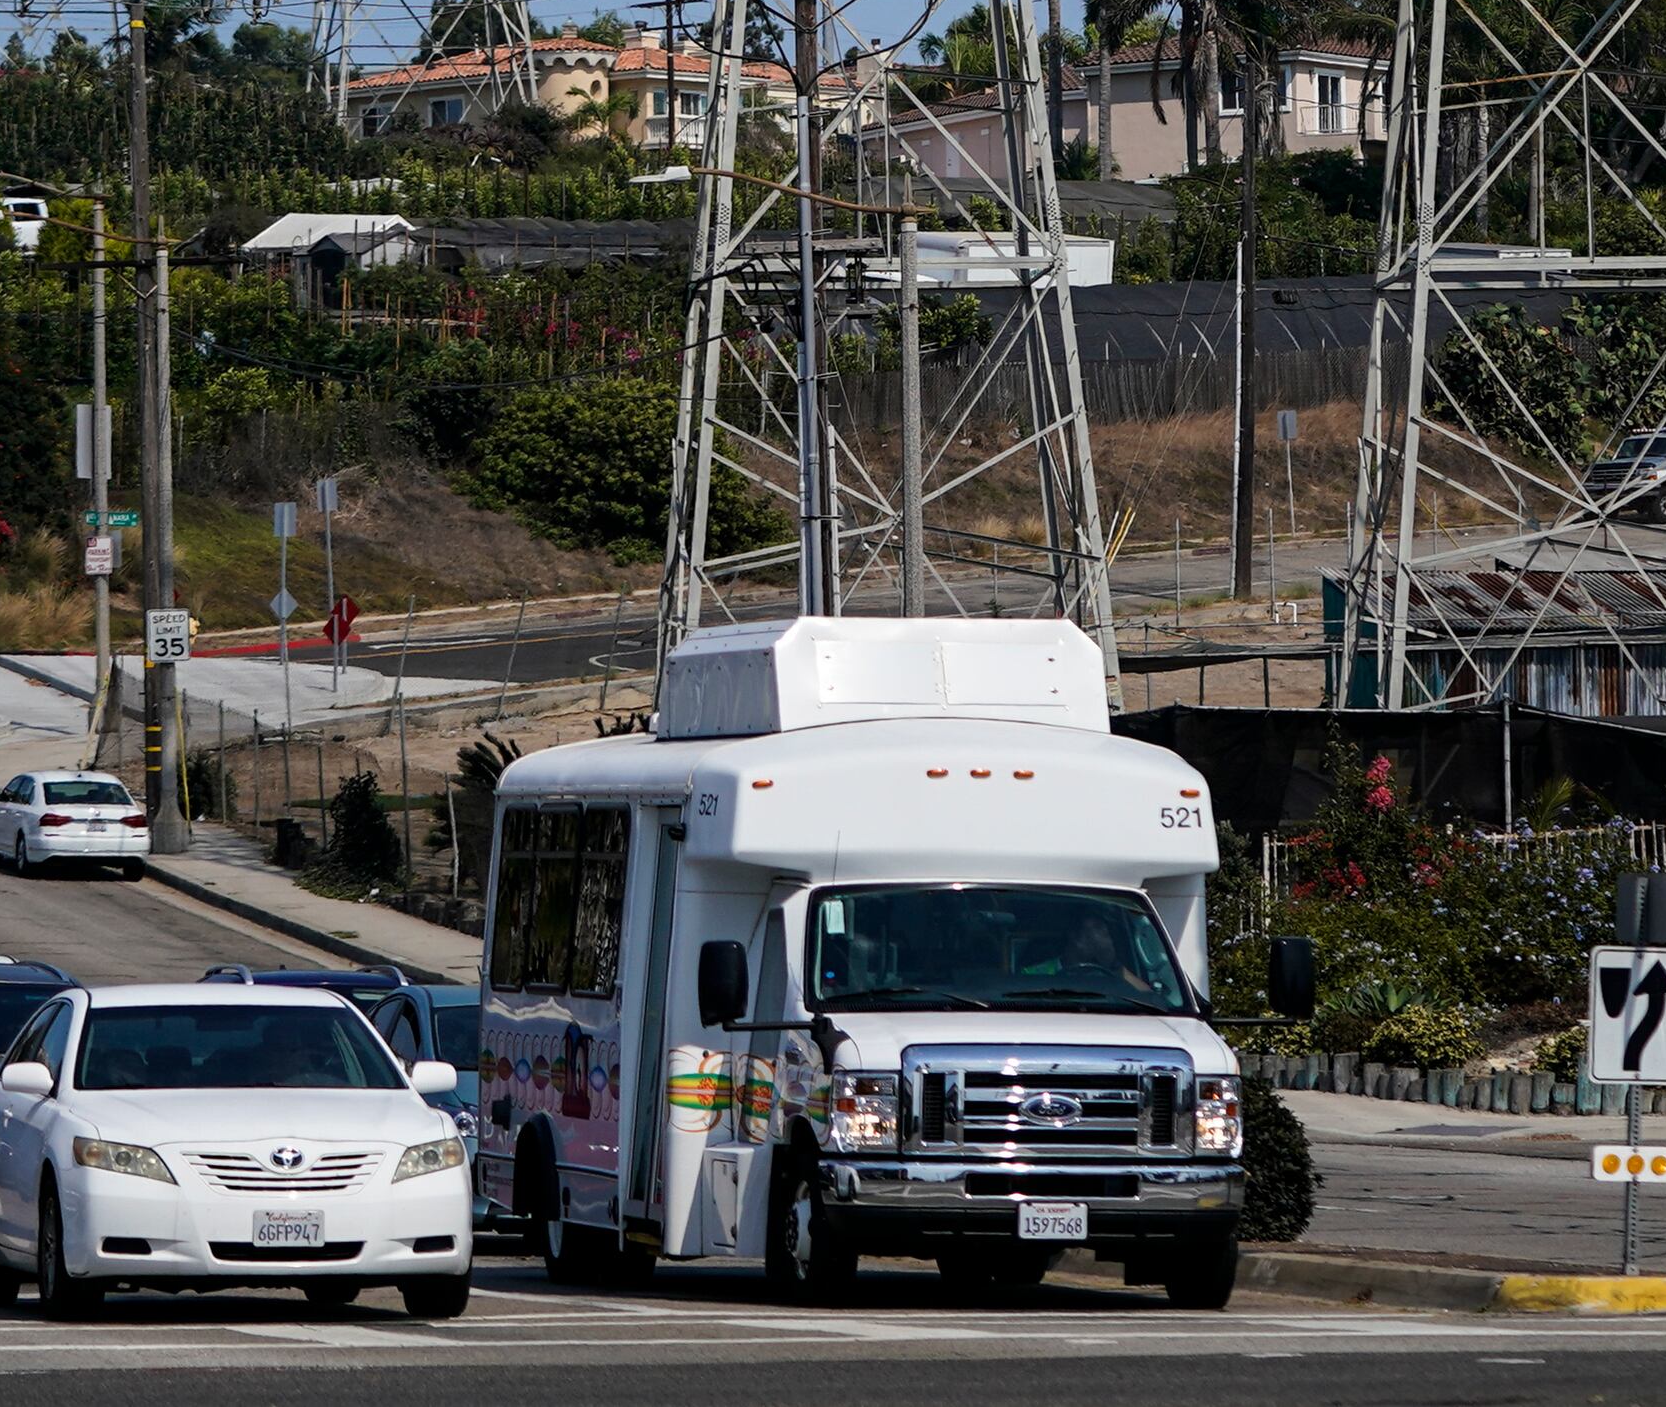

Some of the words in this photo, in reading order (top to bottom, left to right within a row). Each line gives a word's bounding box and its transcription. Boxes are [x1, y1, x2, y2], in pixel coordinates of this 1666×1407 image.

[152, 614, 186, 624] SPEED
[156, 625, 182, 635] LIMIT
[155, 637, 185, 657] 35
[699, 793, 719, 816] 521
[1160, 807, 1202, 829] 521
[258, 1223, 320, 1242] 6GFP947
[1024, 1217, 1083, 1234] 1597568
